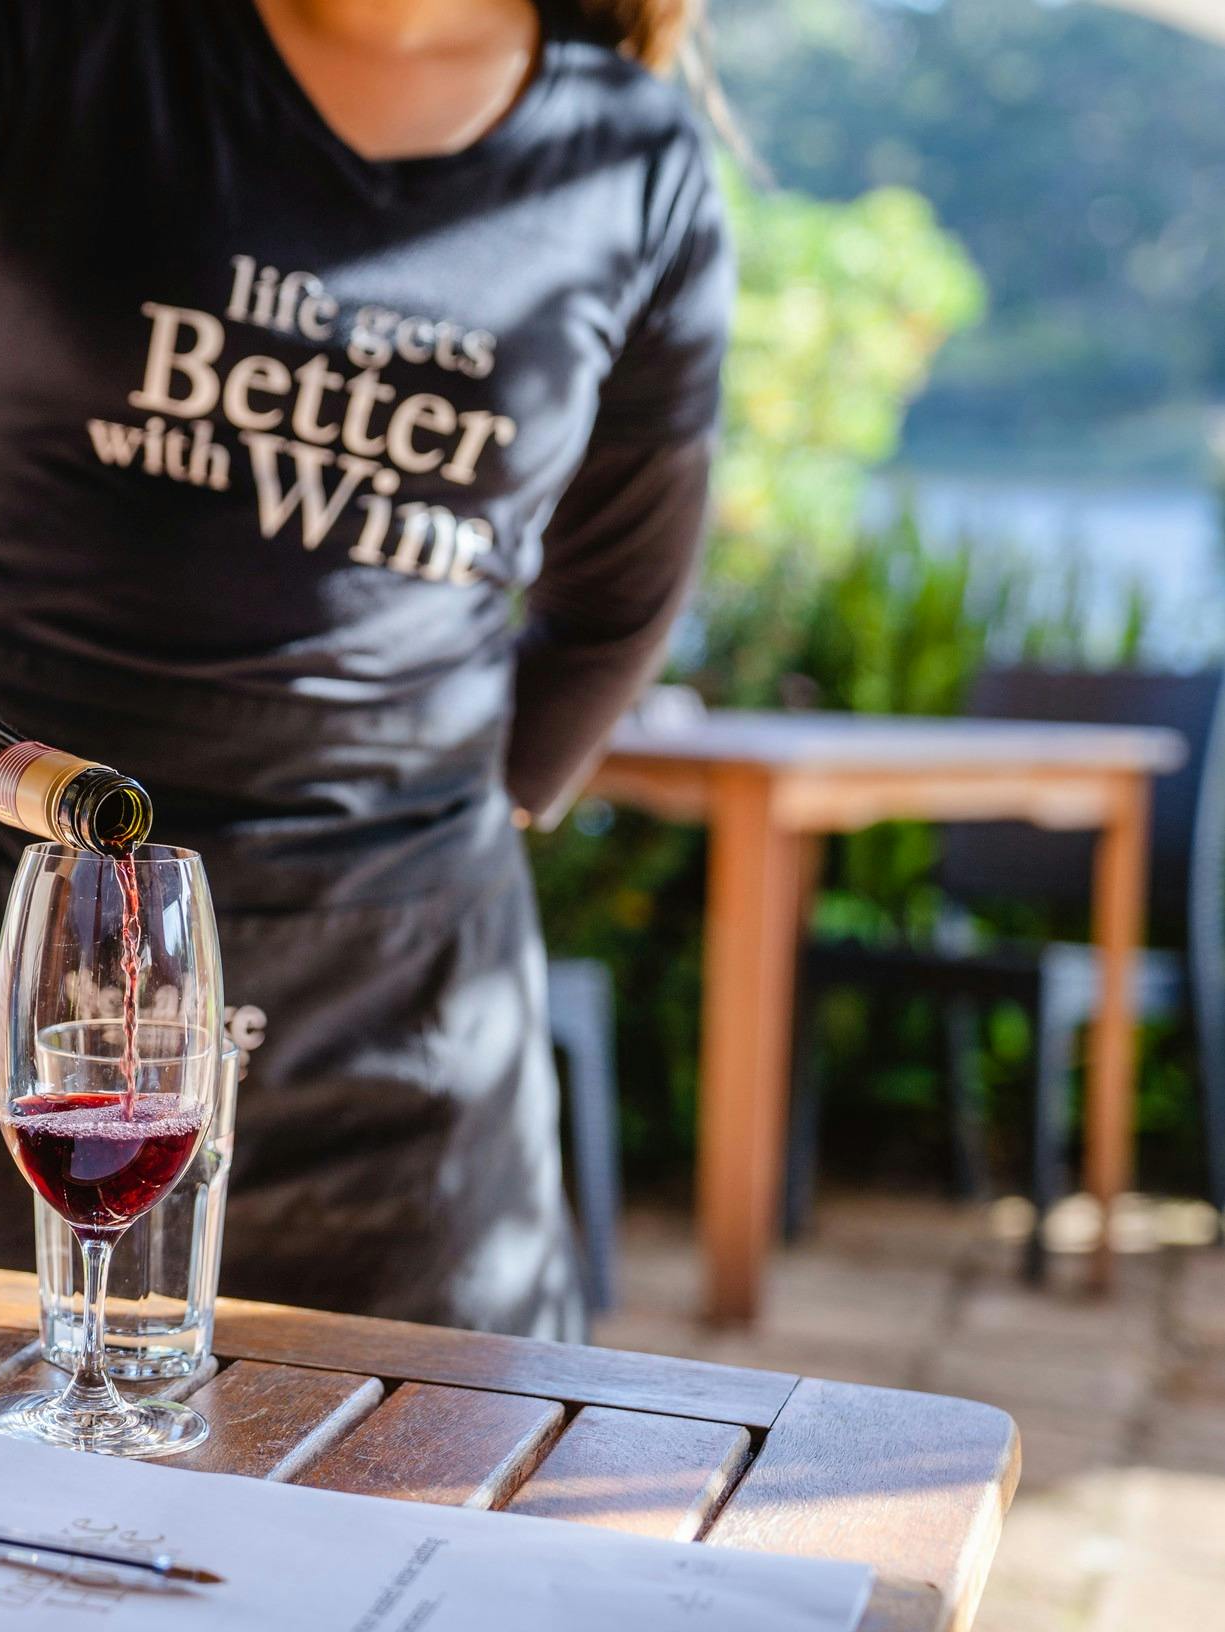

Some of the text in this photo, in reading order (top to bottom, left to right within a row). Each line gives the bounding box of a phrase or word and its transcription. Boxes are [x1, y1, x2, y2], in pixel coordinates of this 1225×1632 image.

[128, 300, 518, 486] Better
[226, 253, 498, 380] life gets
[86, 416, 494, 588] with Wine
